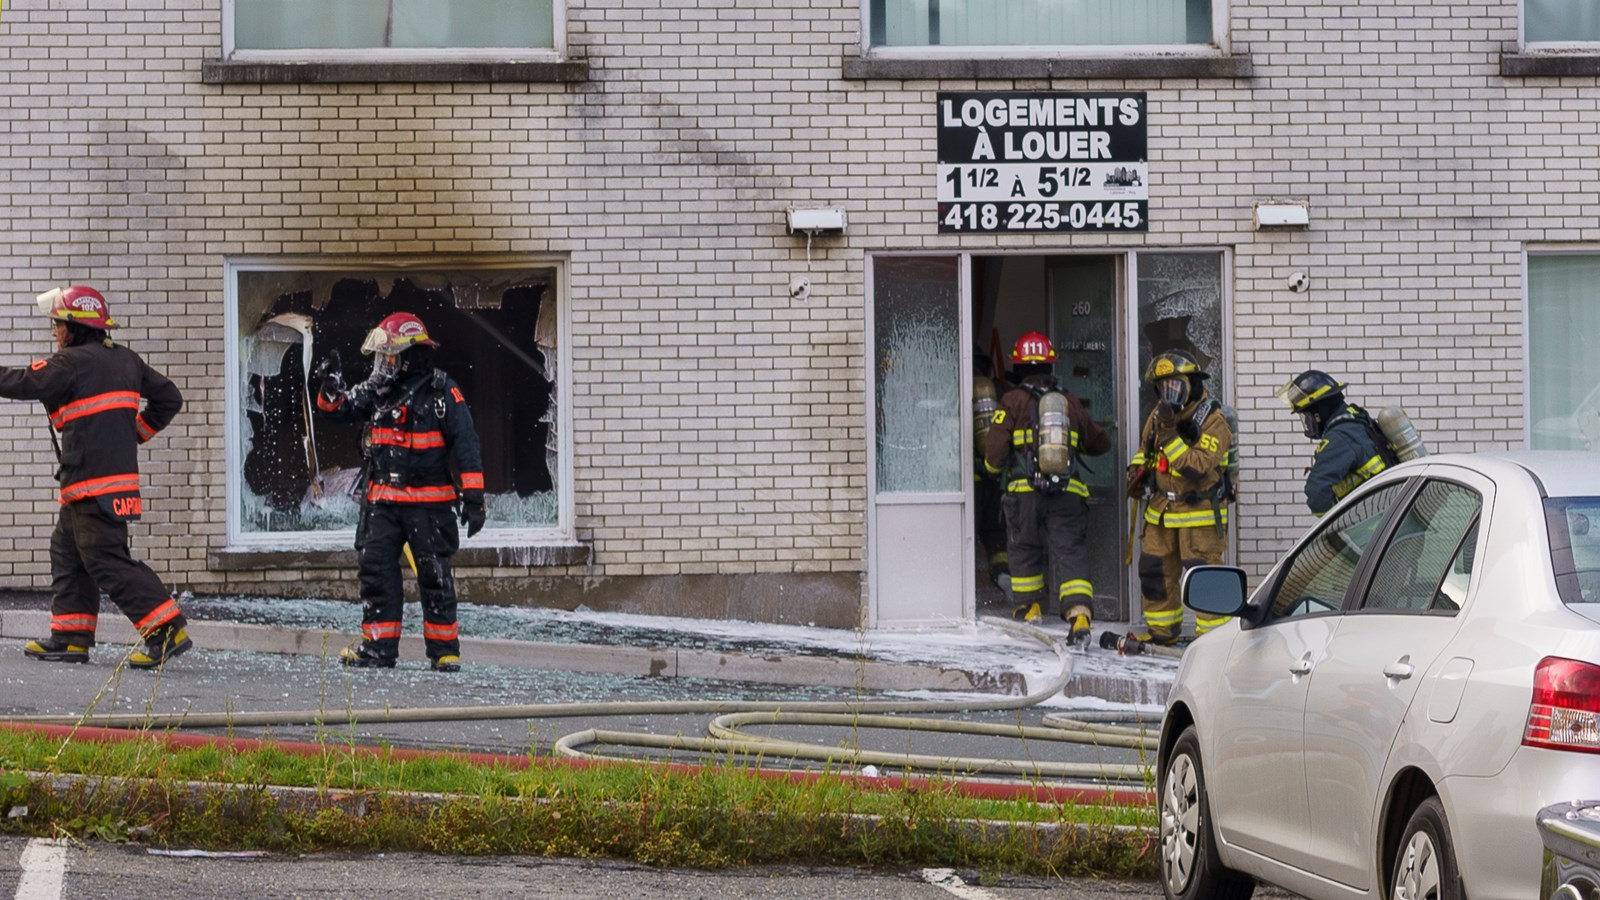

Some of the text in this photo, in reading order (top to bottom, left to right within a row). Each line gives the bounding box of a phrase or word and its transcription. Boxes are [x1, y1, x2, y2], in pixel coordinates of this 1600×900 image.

[943, 98, 1140, 128] LOGEMENTS
[971, 126, 1113, 160] À LOUER
[1010, 174, 1026, 198] À
[944, 202, 1140, 230] 418 225-0445
[81, 303, 95, 311] 102
[1072, 301, 1090, 315] 260
[1022, 341, 1043, 355] 111
